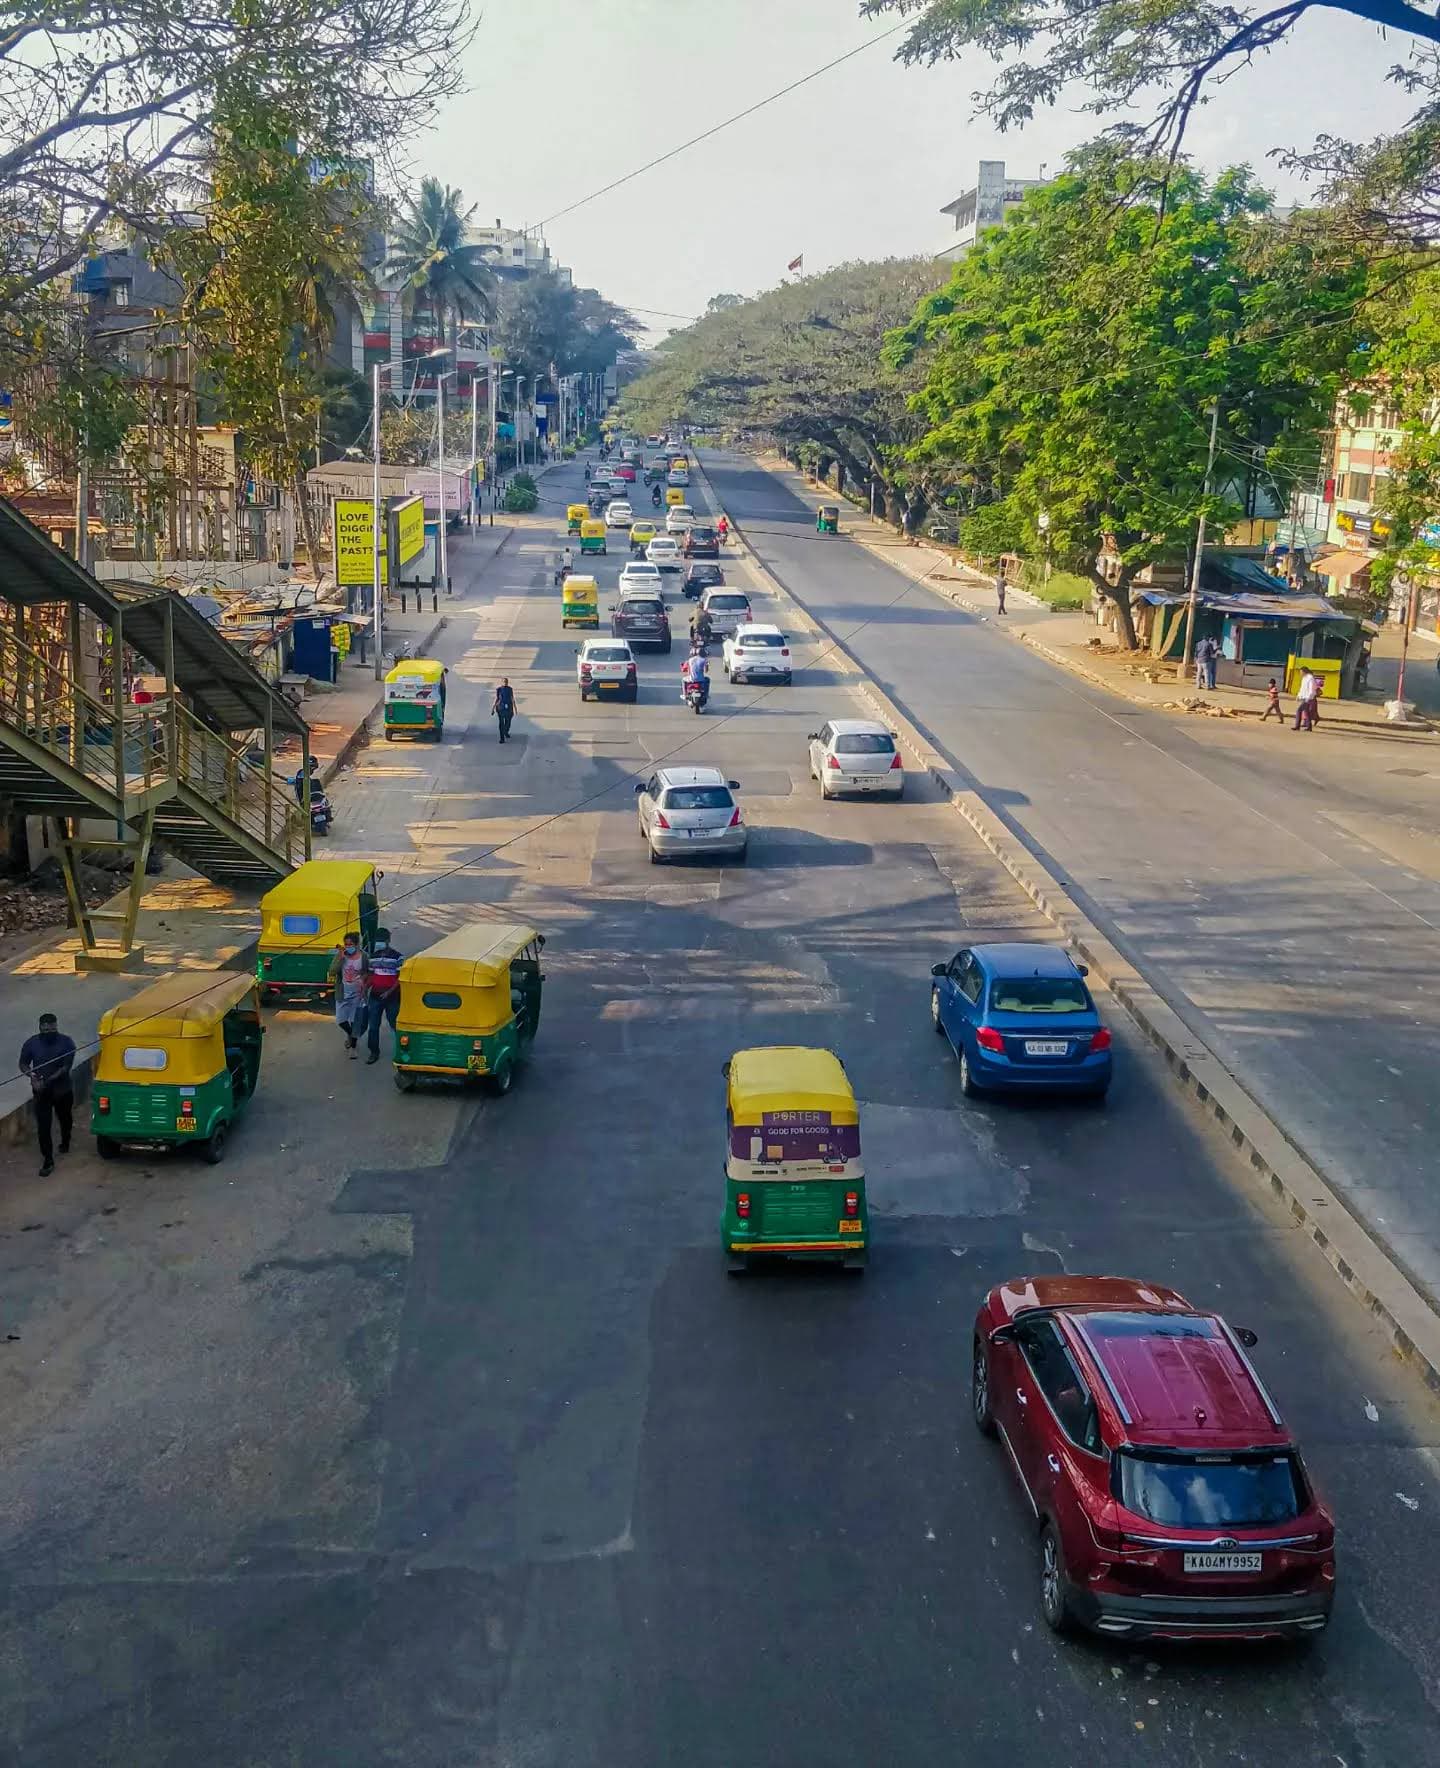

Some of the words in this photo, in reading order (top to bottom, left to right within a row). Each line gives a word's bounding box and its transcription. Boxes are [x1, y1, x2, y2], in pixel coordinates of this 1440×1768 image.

[340, 513, 368, 522] LOVE
[341, 535, 361, 544] THE
[341, 546, 374, 555] PAST?
[773, 1111, 820, 1121] PORTER
[768, 1127, 789, 1135] GOOD
[790, 1127, 804, 1135] FOR
[805, 1126, 829, 1135] GOODS
[1191, 1556, 1260, 1568] KA04MY9952
